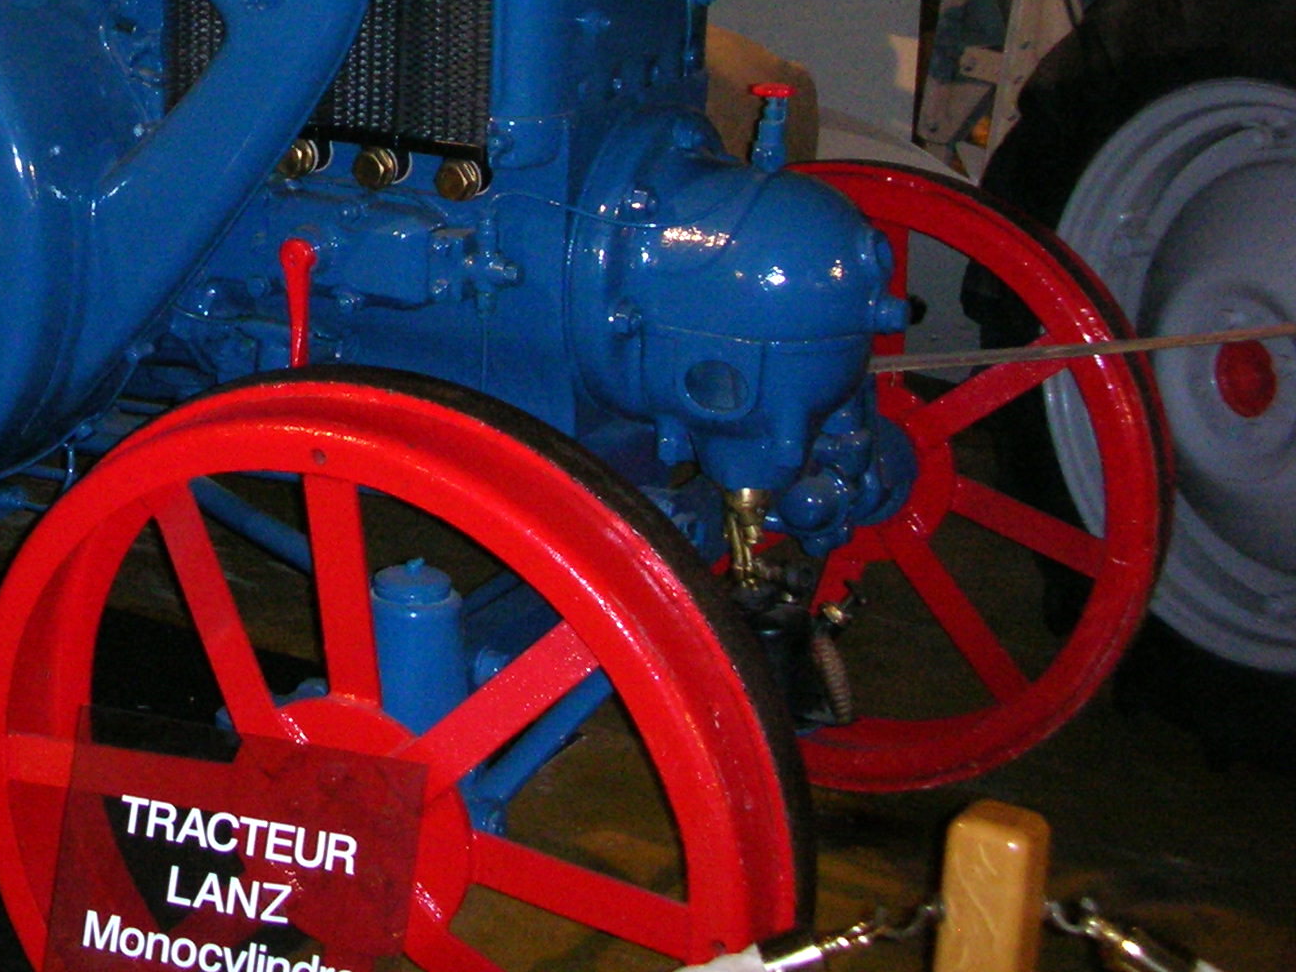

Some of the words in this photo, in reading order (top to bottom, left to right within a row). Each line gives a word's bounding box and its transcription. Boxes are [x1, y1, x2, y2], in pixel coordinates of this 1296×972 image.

[121, 794, 357, 875] TRACTEUR
[166, 865, 293, 924] LANZ
[82, 910, 354, 972] Monocylind
